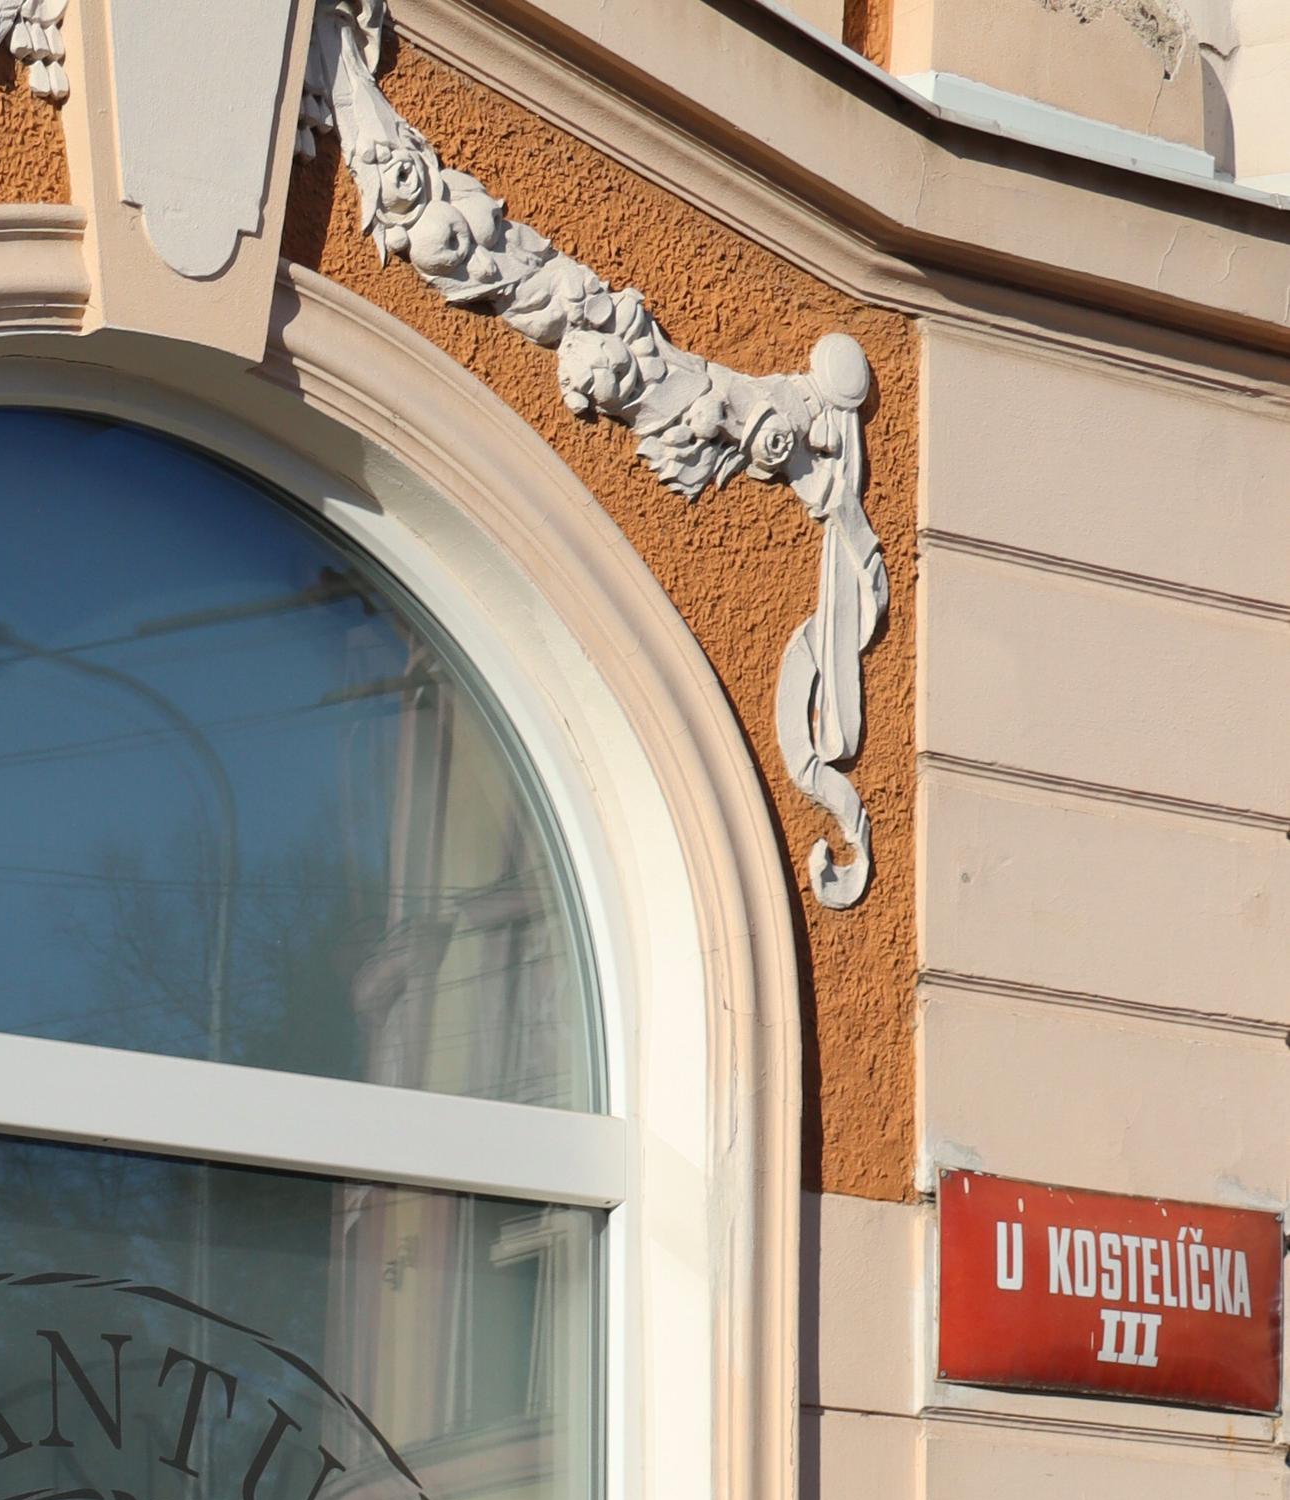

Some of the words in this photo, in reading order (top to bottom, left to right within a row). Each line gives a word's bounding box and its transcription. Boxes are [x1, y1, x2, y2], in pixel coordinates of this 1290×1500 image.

[996, 1221, 1023, 1291] U
[1047, 1226, 1252, 1318] KOSTELÍČKA
[1097, 1308, 1162, 1367] III
